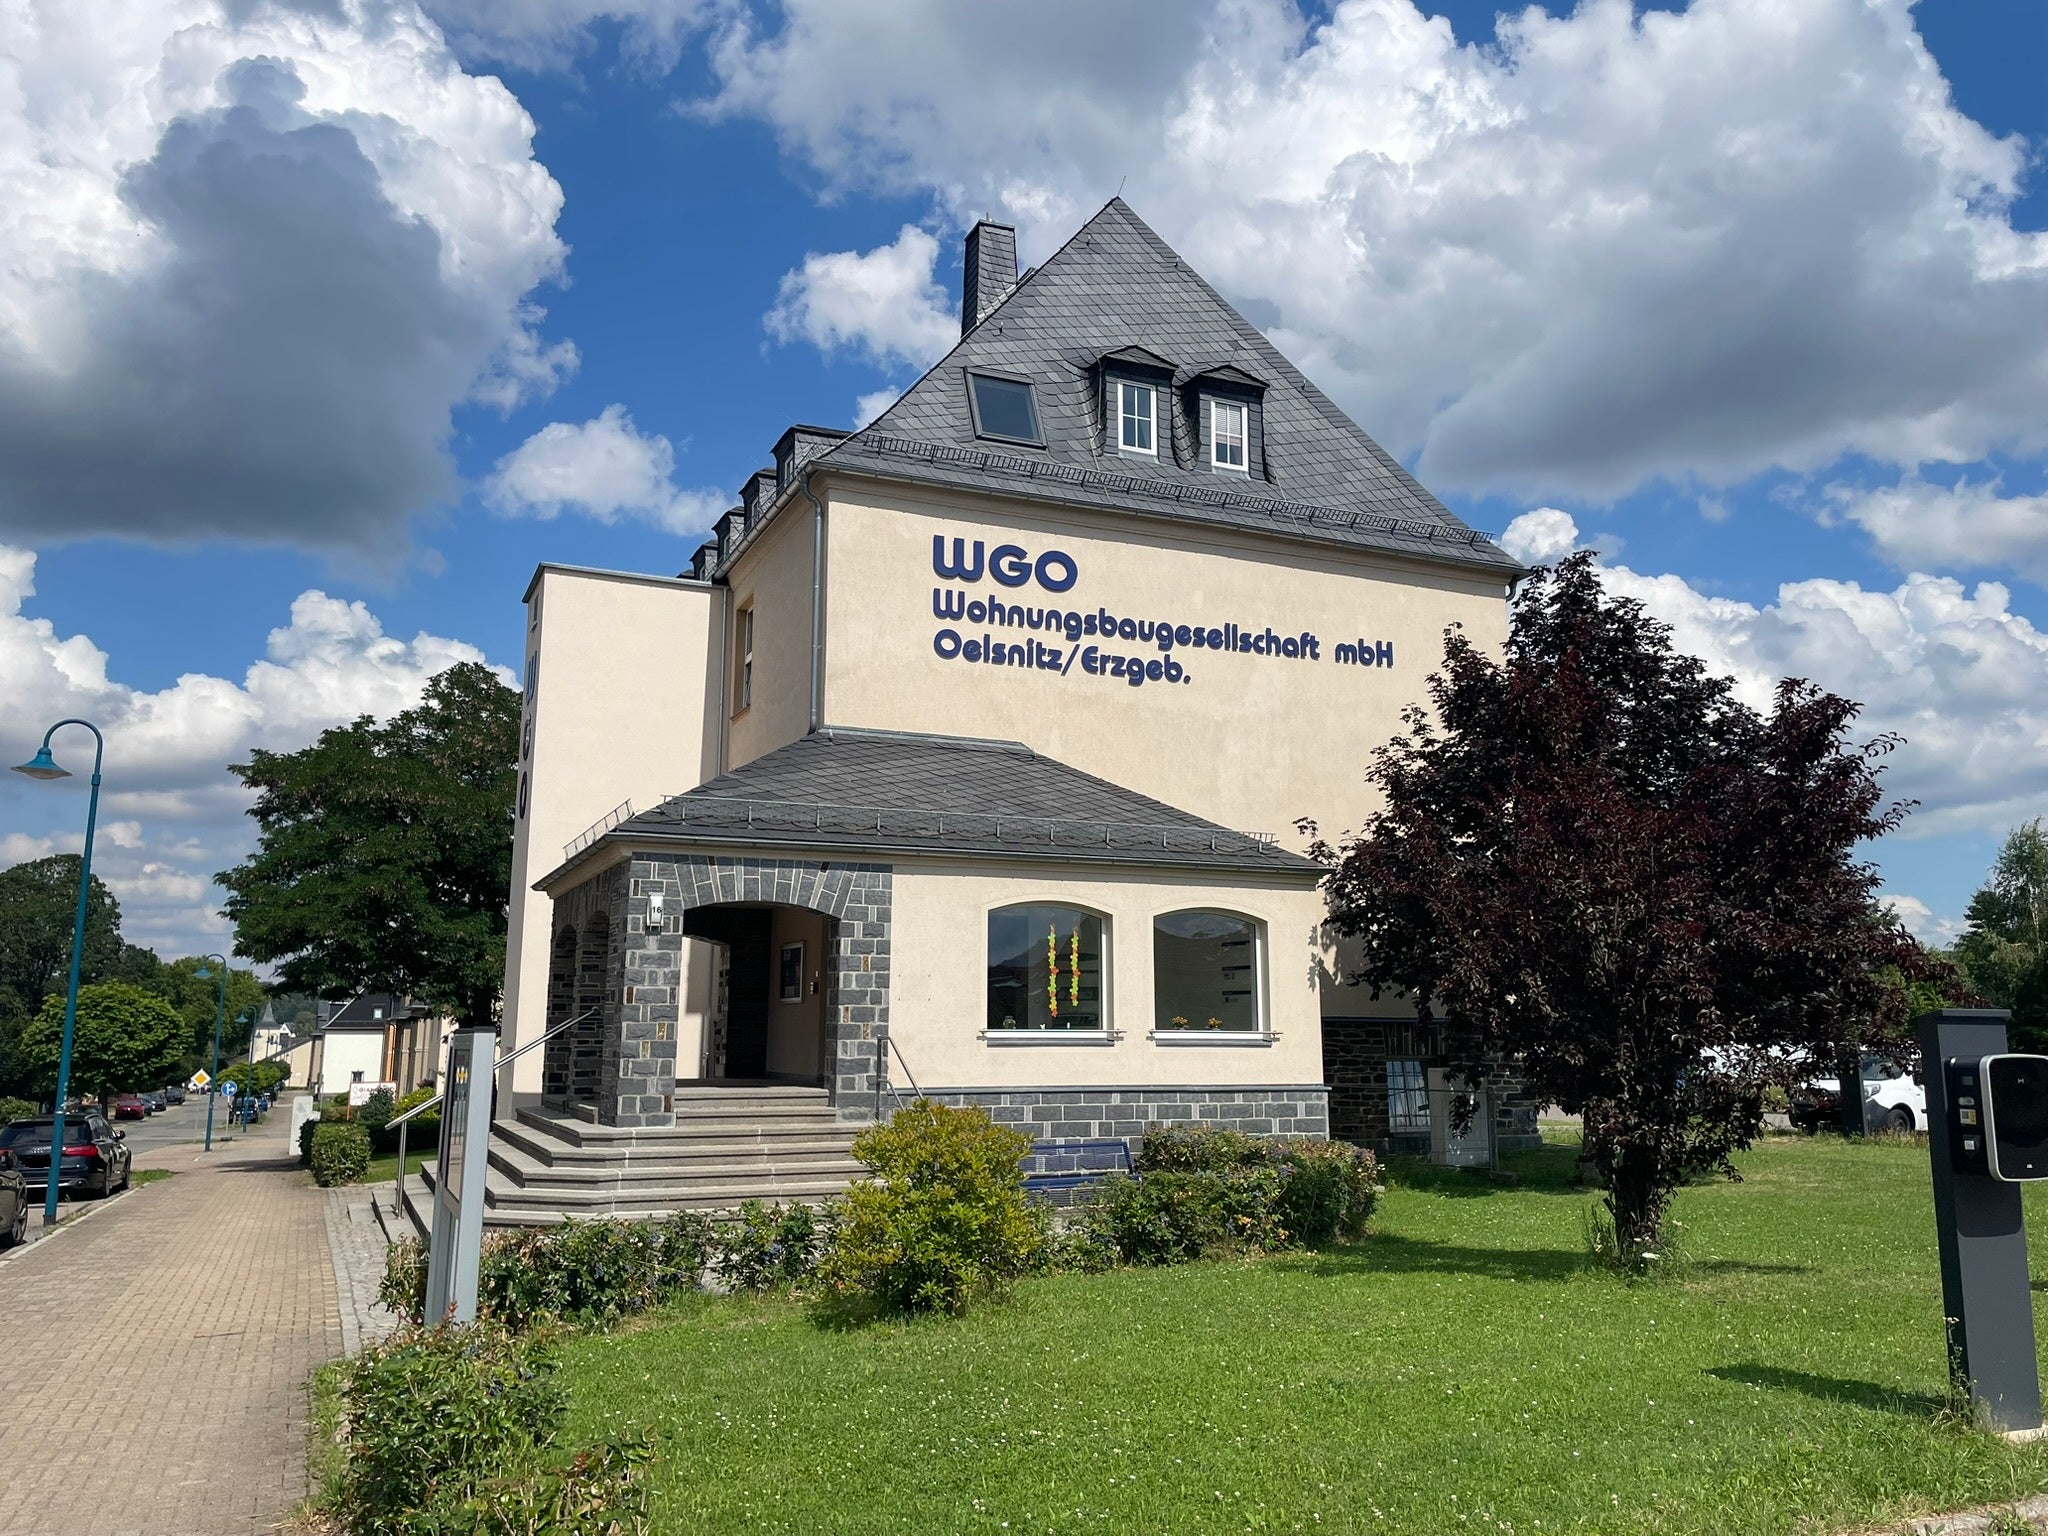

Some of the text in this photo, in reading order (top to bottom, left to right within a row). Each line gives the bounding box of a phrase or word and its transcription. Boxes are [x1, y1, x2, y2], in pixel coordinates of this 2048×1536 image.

[932, 534, 1079, 593] WGO
[932, 588, 1394, 669] Wohnungsbaugesellschaft mbH
[933, 628, 1192, 687] Oelsnitz/Erzgeb.
[652, 906, 663, 914] 16
